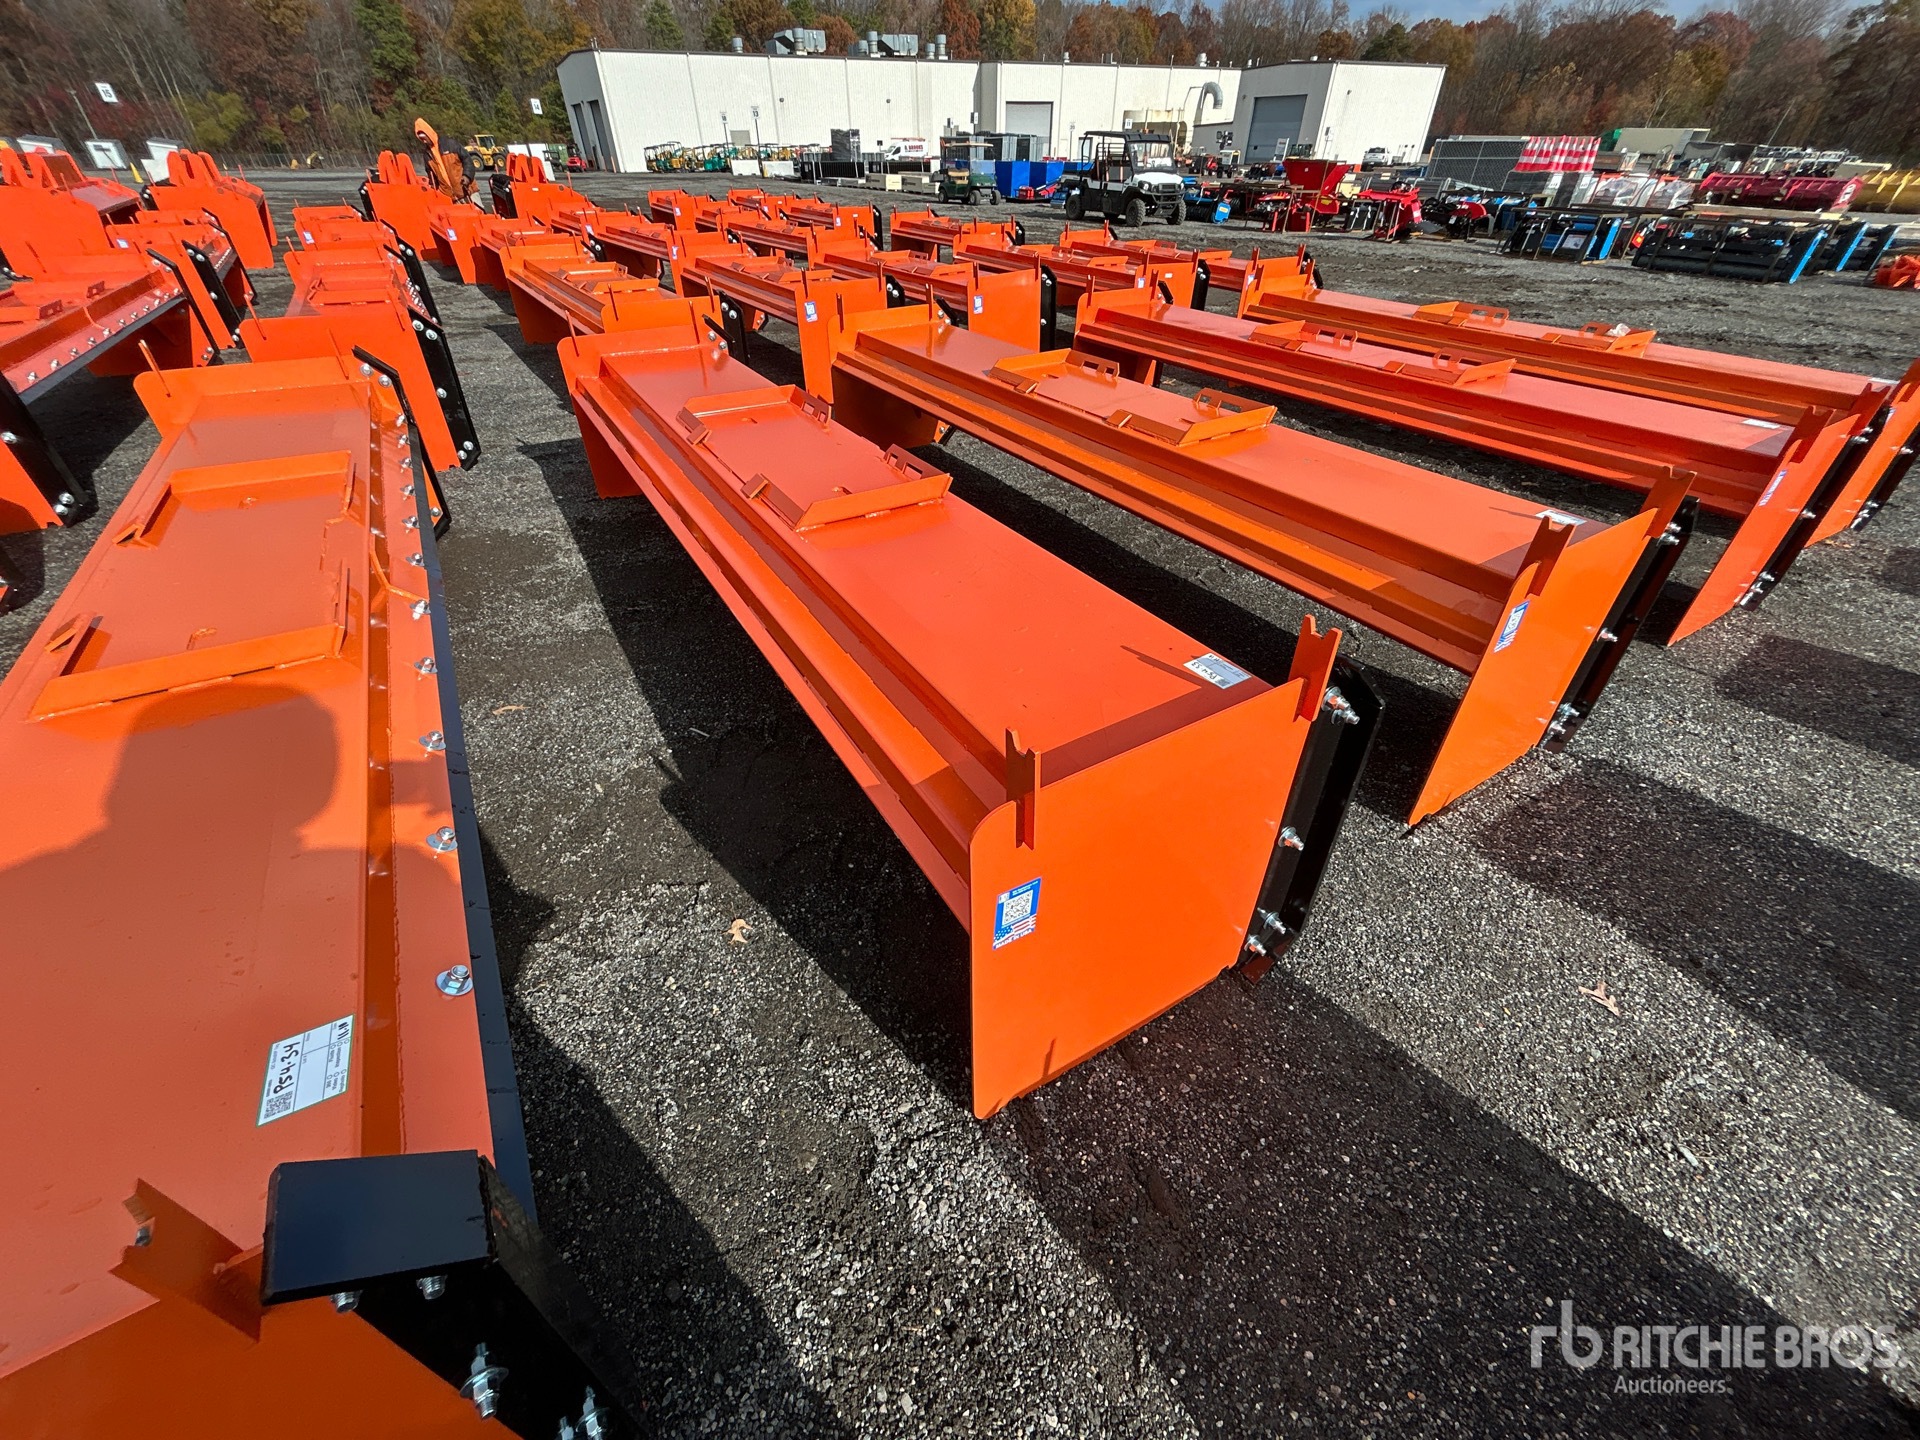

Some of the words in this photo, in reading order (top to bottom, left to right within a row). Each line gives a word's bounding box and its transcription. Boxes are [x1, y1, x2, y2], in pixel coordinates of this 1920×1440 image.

[101, 89, 113, 98] 15
[996, 936, 1011, 949] MADE
[1019, 928, 1033, 939] USA
[273, 1041, 301, 1094] P54.34
